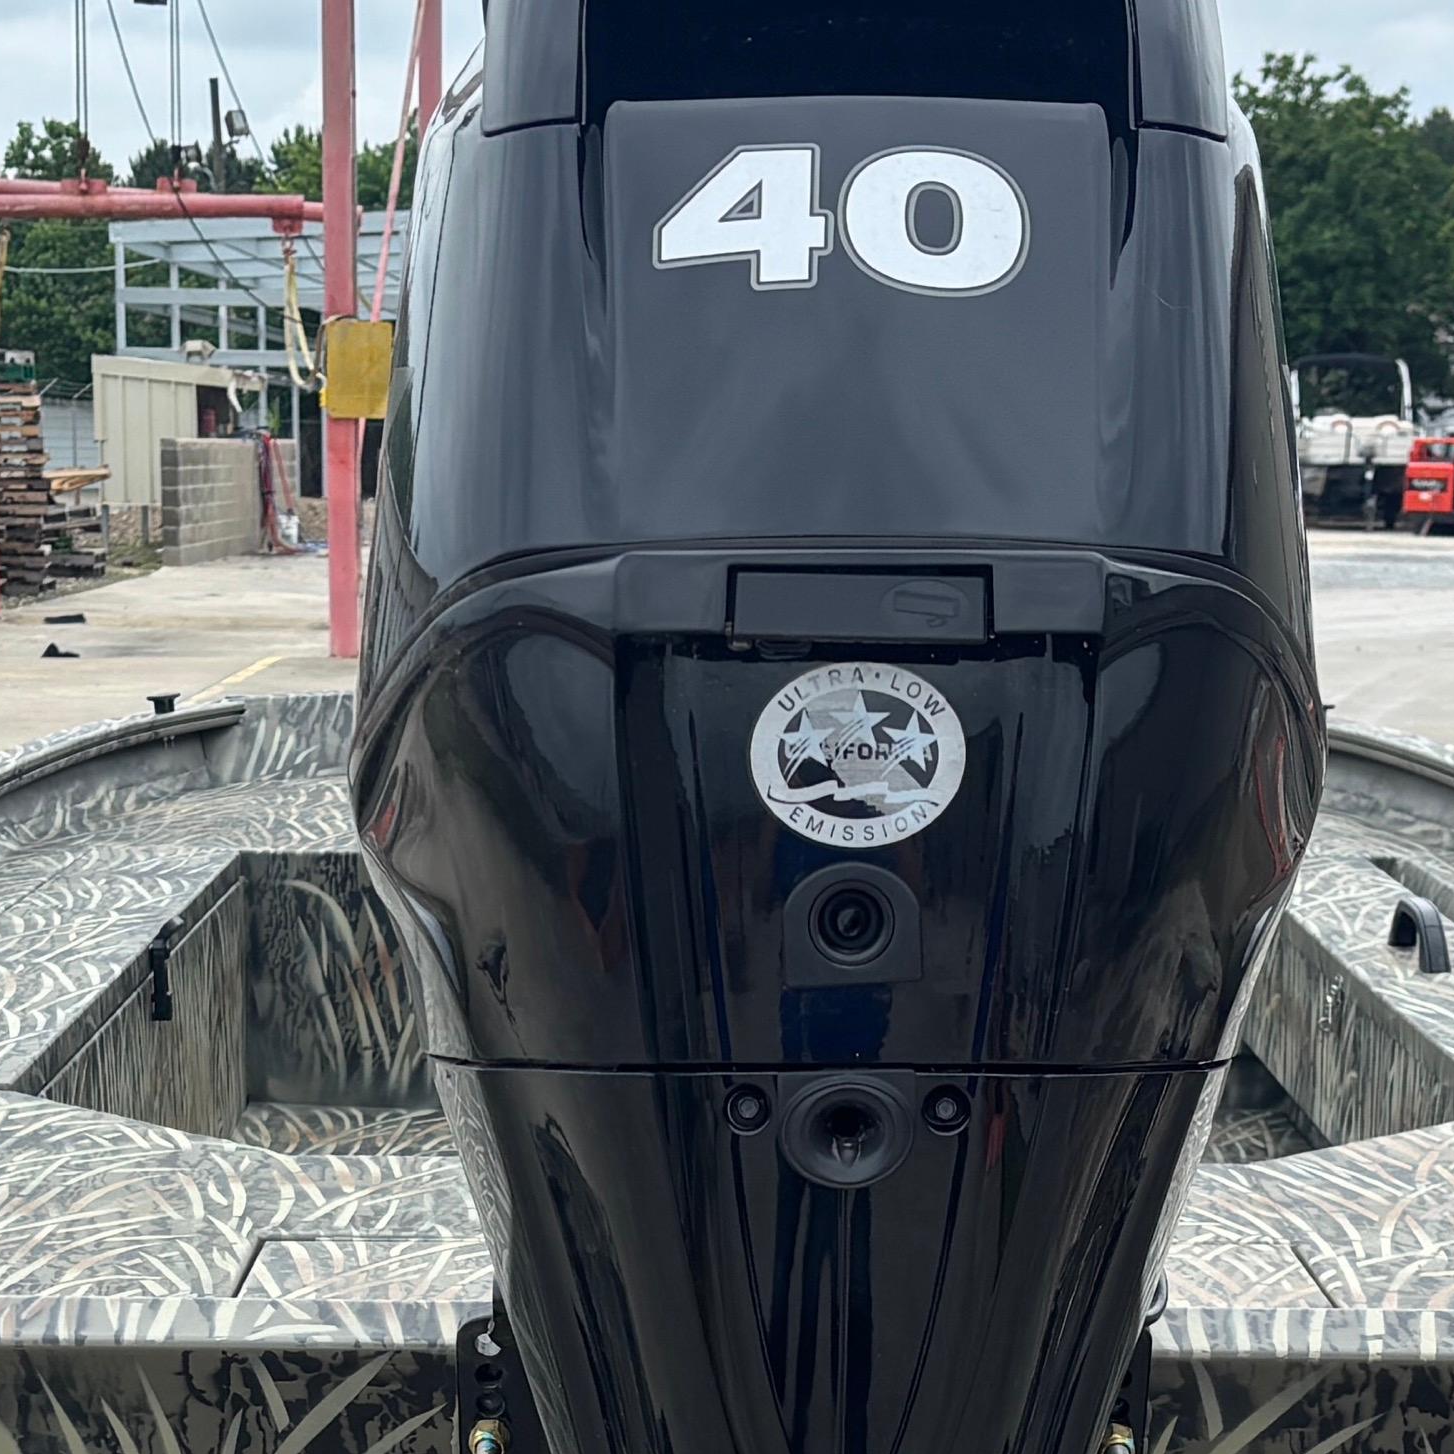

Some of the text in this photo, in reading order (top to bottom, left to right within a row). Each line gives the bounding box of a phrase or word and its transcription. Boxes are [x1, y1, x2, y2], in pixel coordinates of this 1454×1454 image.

[655, 145, 1028, 294] 40
[777, 666, 946, 718] ULTRA LOW
[788, 804, 928, 842] EMISSION
